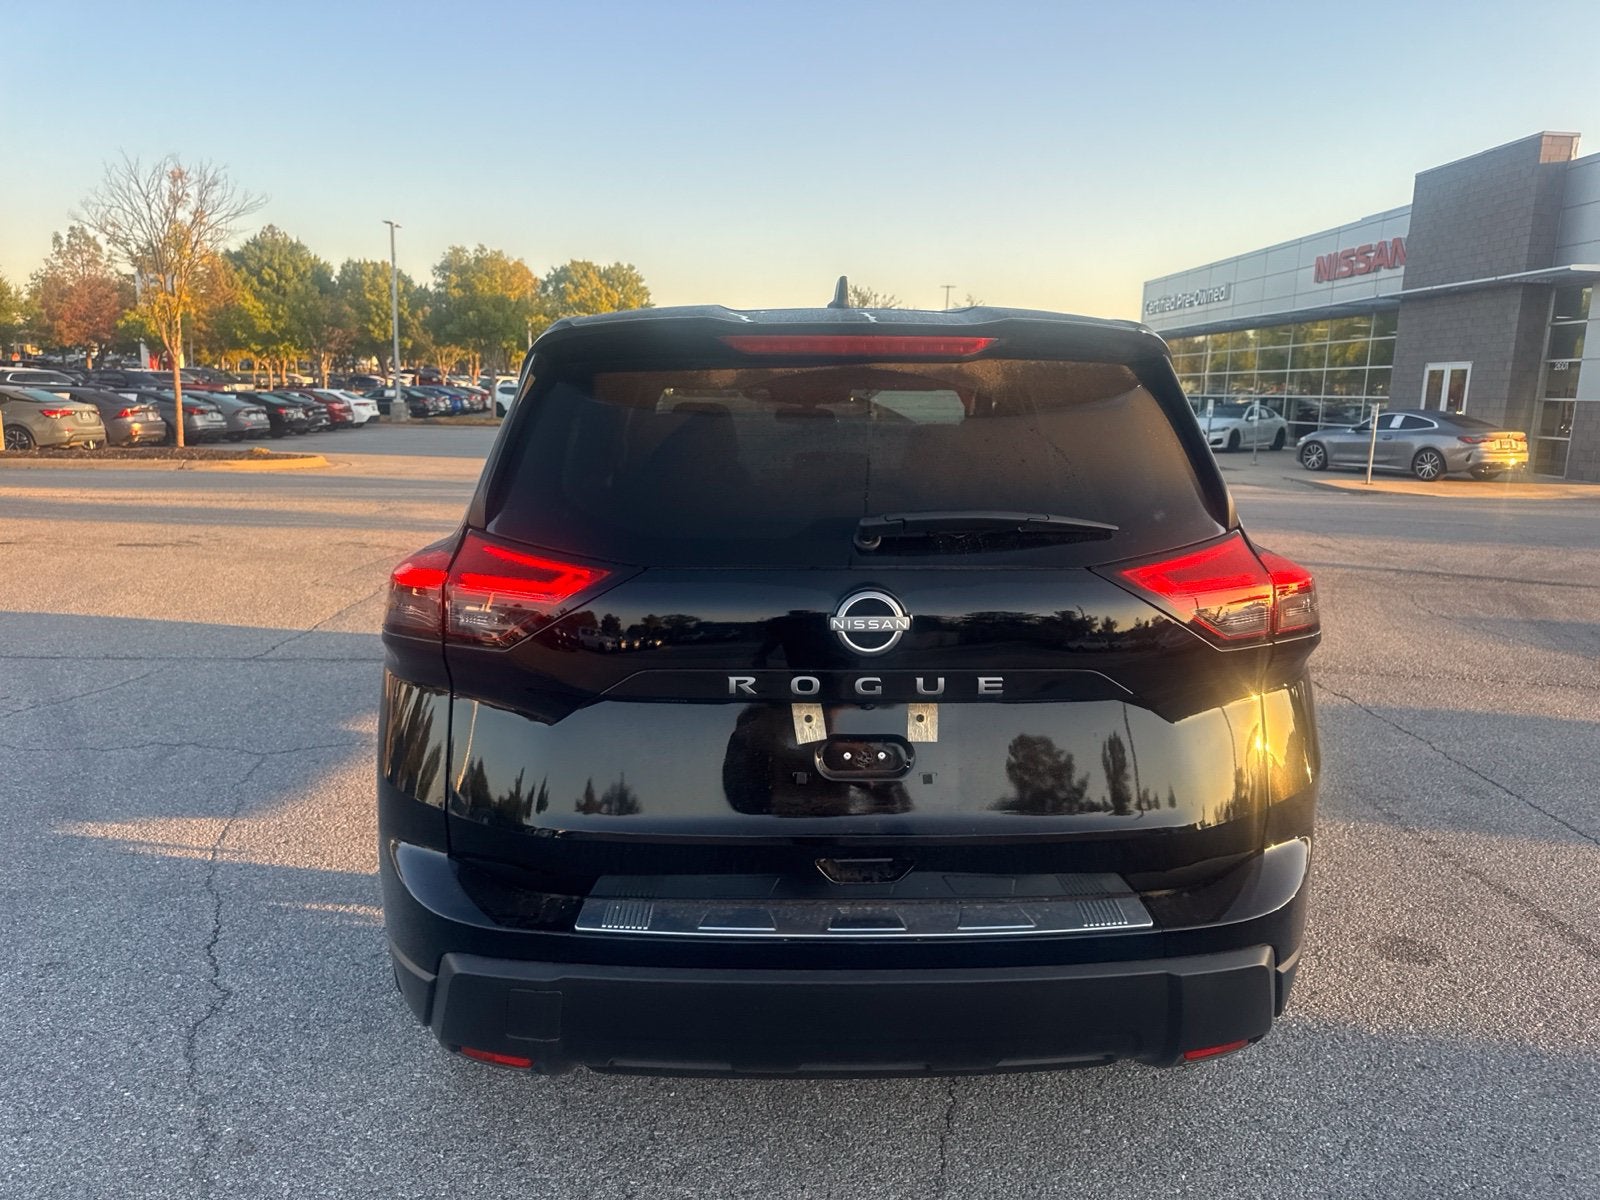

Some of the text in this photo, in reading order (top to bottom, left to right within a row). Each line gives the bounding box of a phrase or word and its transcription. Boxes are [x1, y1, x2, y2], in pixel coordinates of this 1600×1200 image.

[1314, 237, 1406, 284] NISSAN
[1145, 284, 1228, 315] Certified Pre-Owned
[832, 618, 908, 630] NISSAN
[728, 676, 1004, 695] ROGUE
